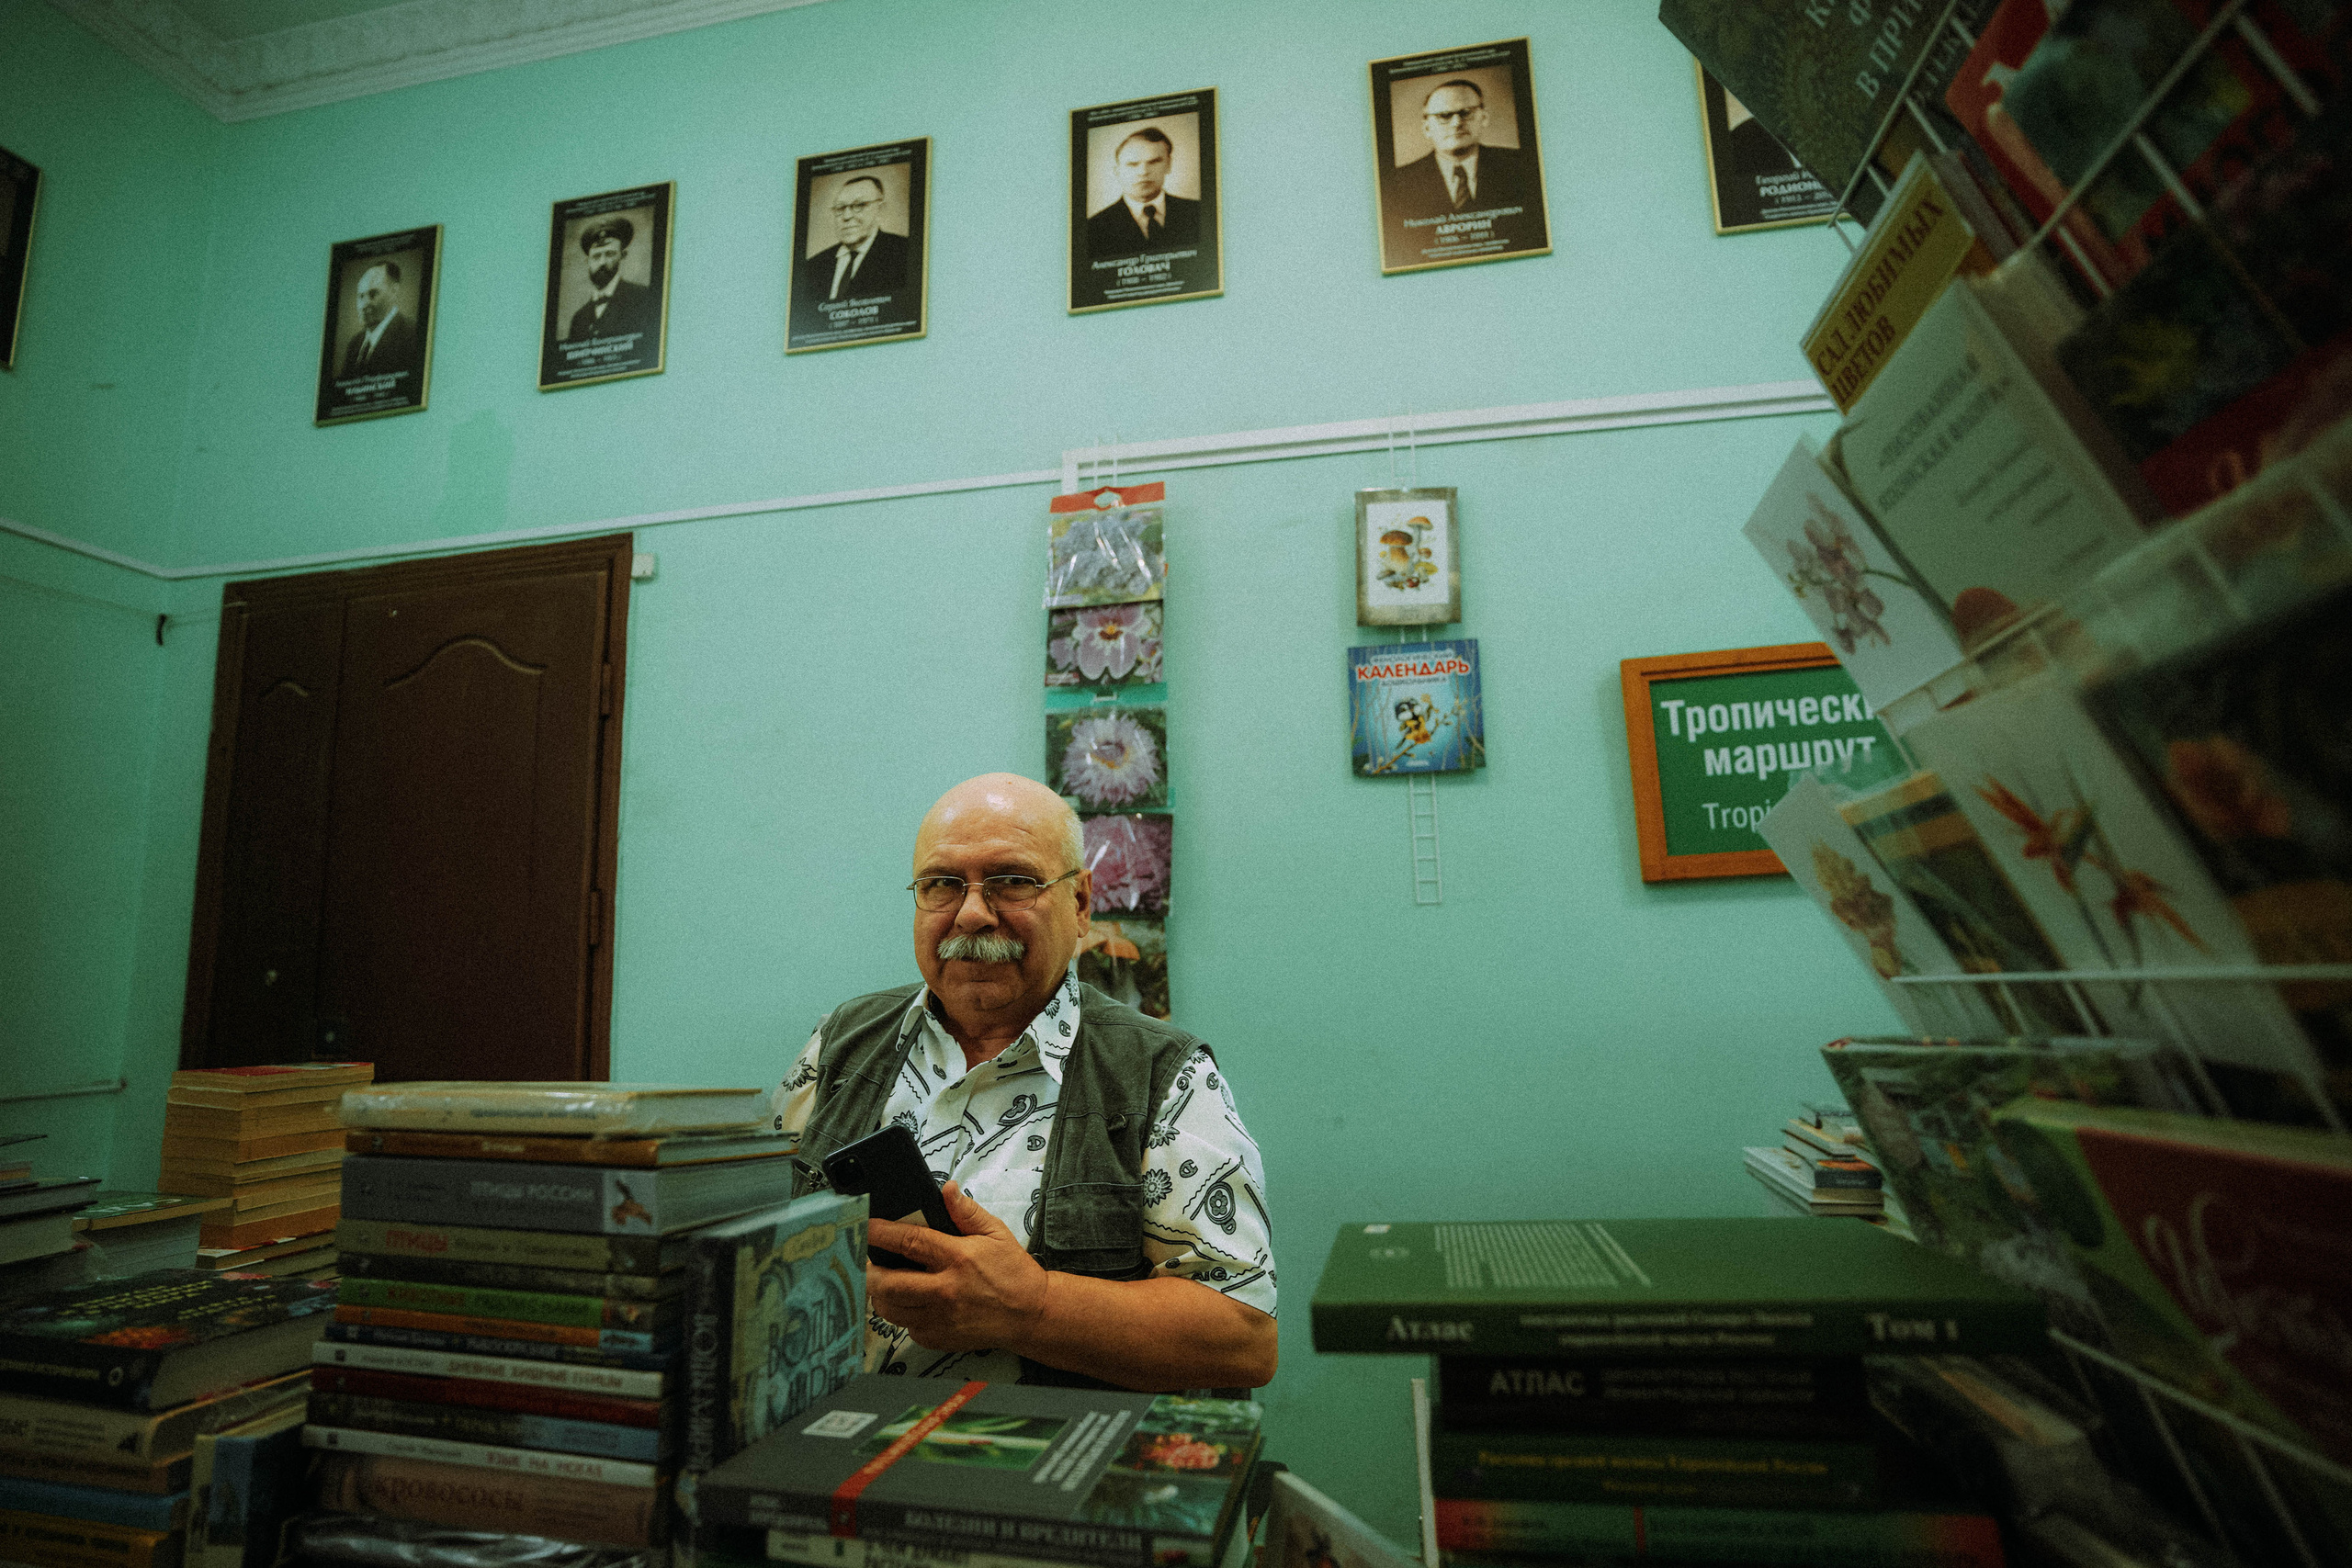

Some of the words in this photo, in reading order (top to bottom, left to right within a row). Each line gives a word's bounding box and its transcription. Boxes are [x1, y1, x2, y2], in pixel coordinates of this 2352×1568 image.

[1117, 260, 1171, 276] ГОЛОВАЧ
[1849, 194, 1946, 345] ЛЮБИМЫХ
[829, 305, 879, 321] СОКОЛОВ
[1831, 315, 1897, 406] ЦВЕТОВ
[1357, 660, 1470, 681] КАЛЕНДАРЬ
[1703, 735, 1876, 781] маршрут
[1702, 798, 1771, 834] Tropi
[526, 1184, 597, 1202] РОССИИ
[385, 1229, 449, 1254] ПТИЦЫ
[1864, 1312, 1935, 1340] Том
[1489, 1369, 1587, 1397] АТЛАС
